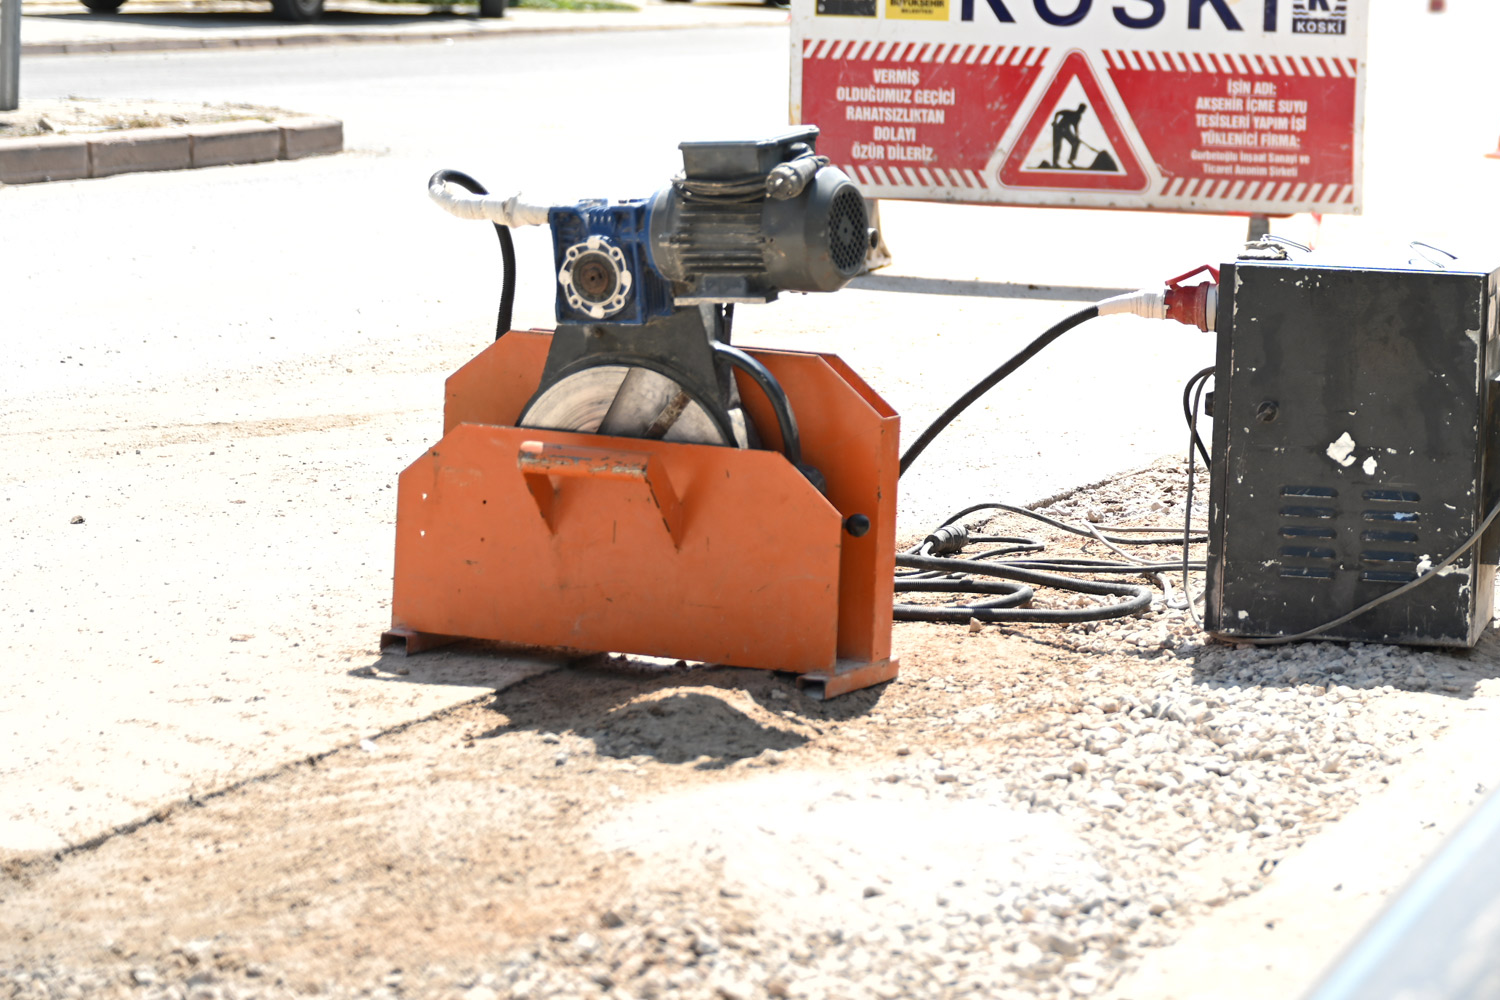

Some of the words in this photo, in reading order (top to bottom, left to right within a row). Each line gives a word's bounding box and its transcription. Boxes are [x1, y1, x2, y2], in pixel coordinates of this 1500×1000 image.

[1296, 19, 1343, 34] KOSKİ
[873, 67, 920, 87] VERMİŞ
[836, 86, 912, 103] OLDUĞUMUZ
[914, 87, 956, 106] GEÇİCİ
[1227, 78, 1252, 97] İŞİN
[1253, 81, 1277, 96] ADI:
[1195, 96, 1244, 112] AKŞEHİR
[1246, 96, 1275, 114] İÇME
[1278, 100, 1308, 114] SUYU
[846, 106, 945, 124] RAHATSIZLIKTAN
[1195, 112, 1250, 129] TESİSLERİ
[1252, 116, 1289, 131] YAPIM
[1290, 114, 1307, 132] İŞİ
[873, 126, 916, 142] DOLAYI
[1201, 129, 1259, 147] YÜKLENİCİ
[1260, 131, 1301, 148] FİRMA:
[852, 141, 885, 160] ÖZÜR
